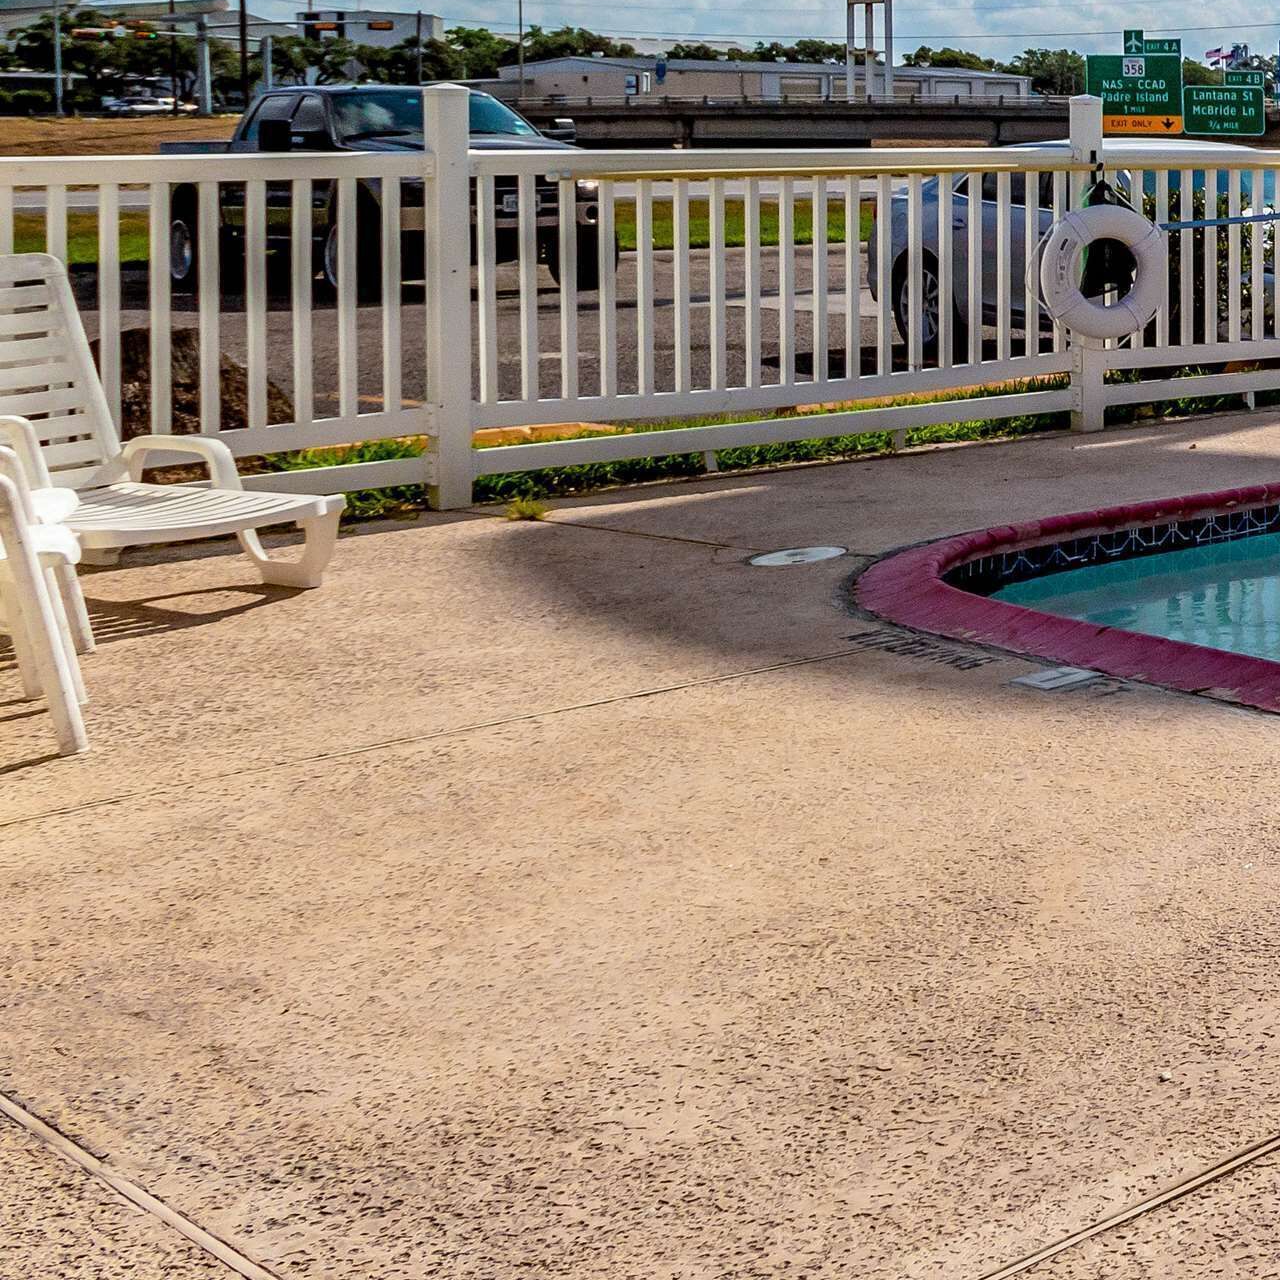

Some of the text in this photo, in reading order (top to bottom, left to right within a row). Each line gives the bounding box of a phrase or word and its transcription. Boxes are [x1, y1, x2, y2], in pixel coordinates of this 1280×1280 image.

[1124, 64, 1144, 75] 358
[1102, 80, 1124, 89] NAS
[1137, 80, 1166, 89] CCAD
[1101, 91, 1169, 102] Padre Island
[1193, 90, 1254, 100] Lantana St
[1192, 104, 1255, 116] McBride Ln
[1111, 119, 1153, 128] EXIT ONLY
[1223, 121, 1240, 129] MILE
